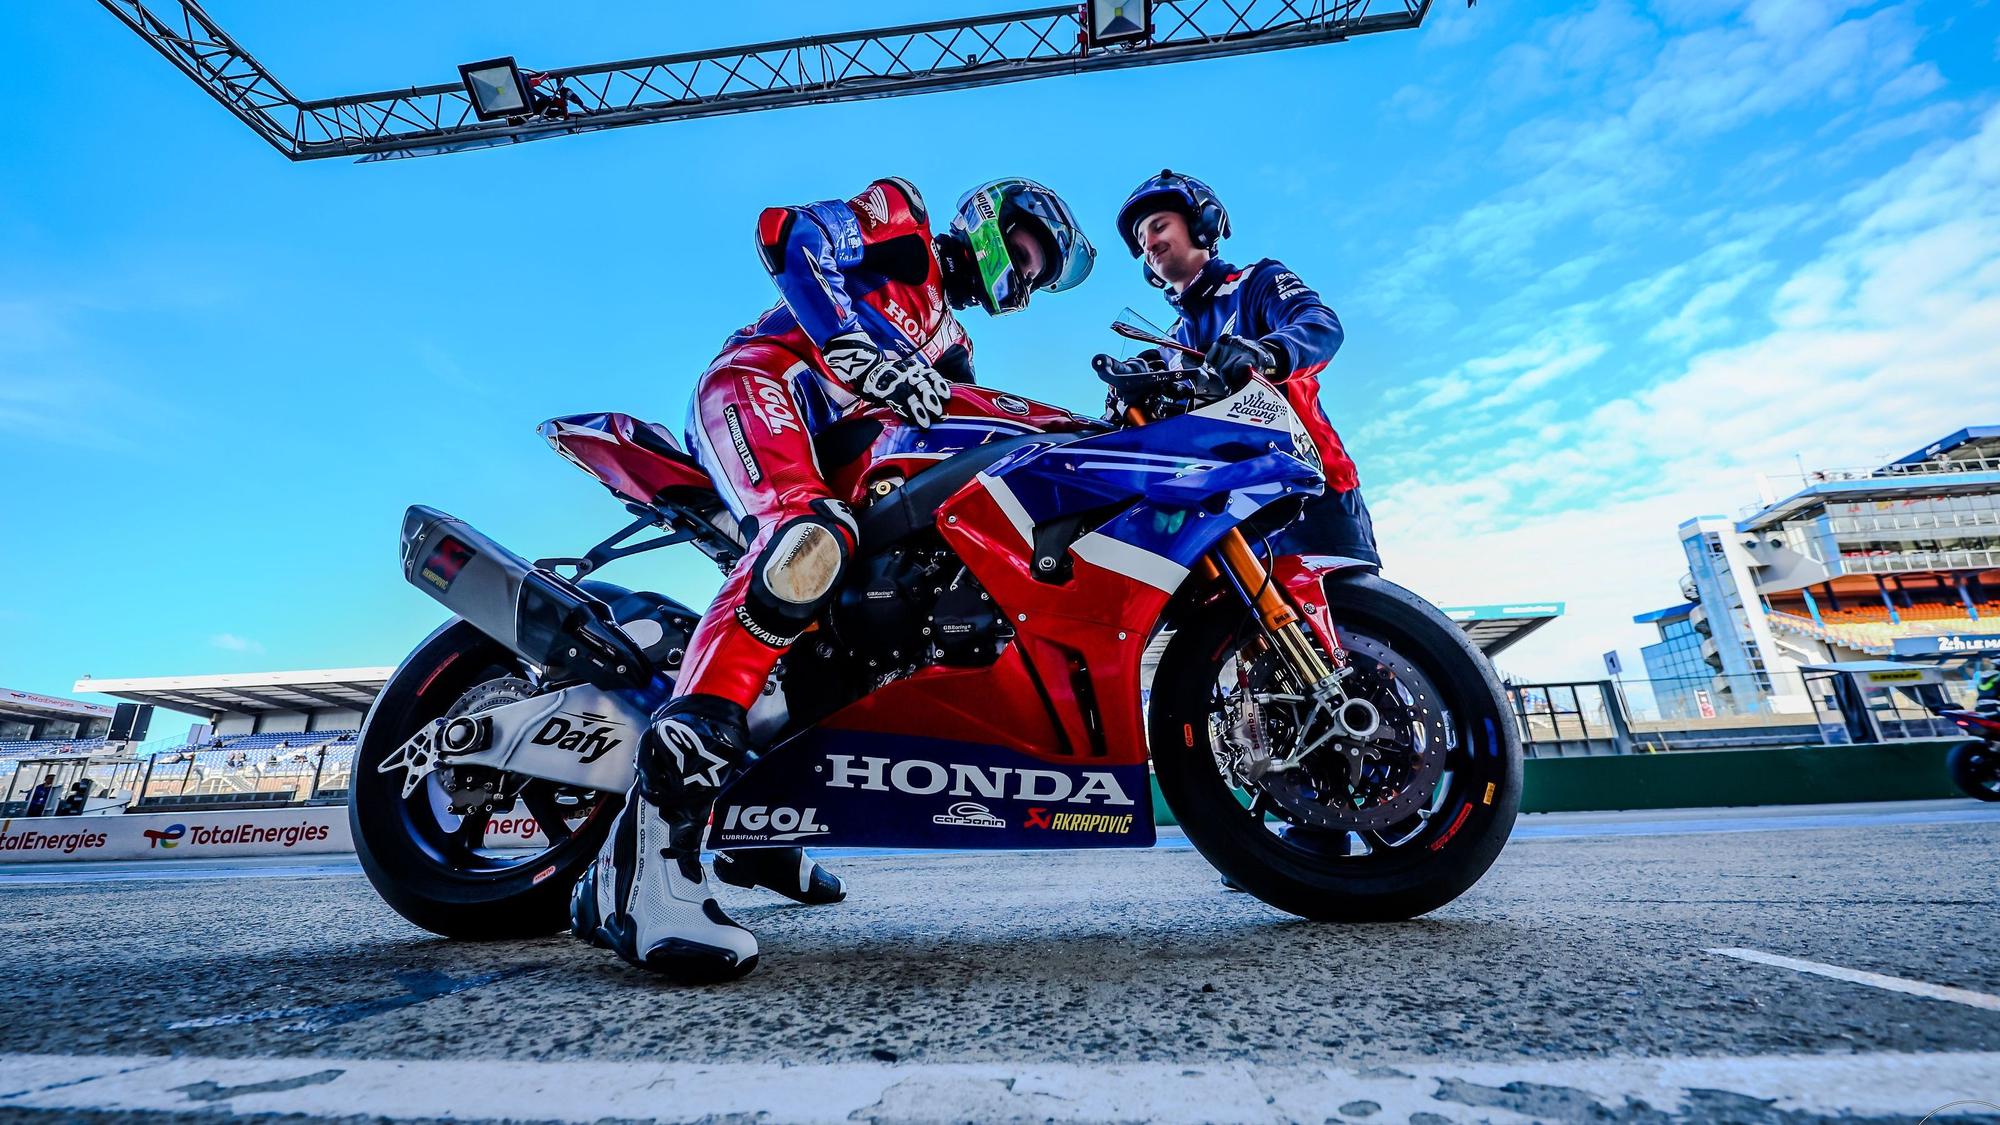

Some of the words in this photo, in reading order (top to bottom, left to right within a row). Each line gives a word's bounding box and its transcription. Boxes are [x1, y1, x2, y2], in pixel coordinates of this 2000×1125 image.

[852, 197, 877, 229] HONDA
[976, 192, 996, 220] NOLAN
[1230, 402, 1276, 424] Racing
[1608, 656, 1616, 668] 1
[27, 694, 75, 708] TotalEnergies
[530, 716, 624, 764] Dafy
[1247, 712, 1260, 750] brembo
[825, 754, 1135, 806] HONDA
[189, 820, 330, 848] TotalEnergies
